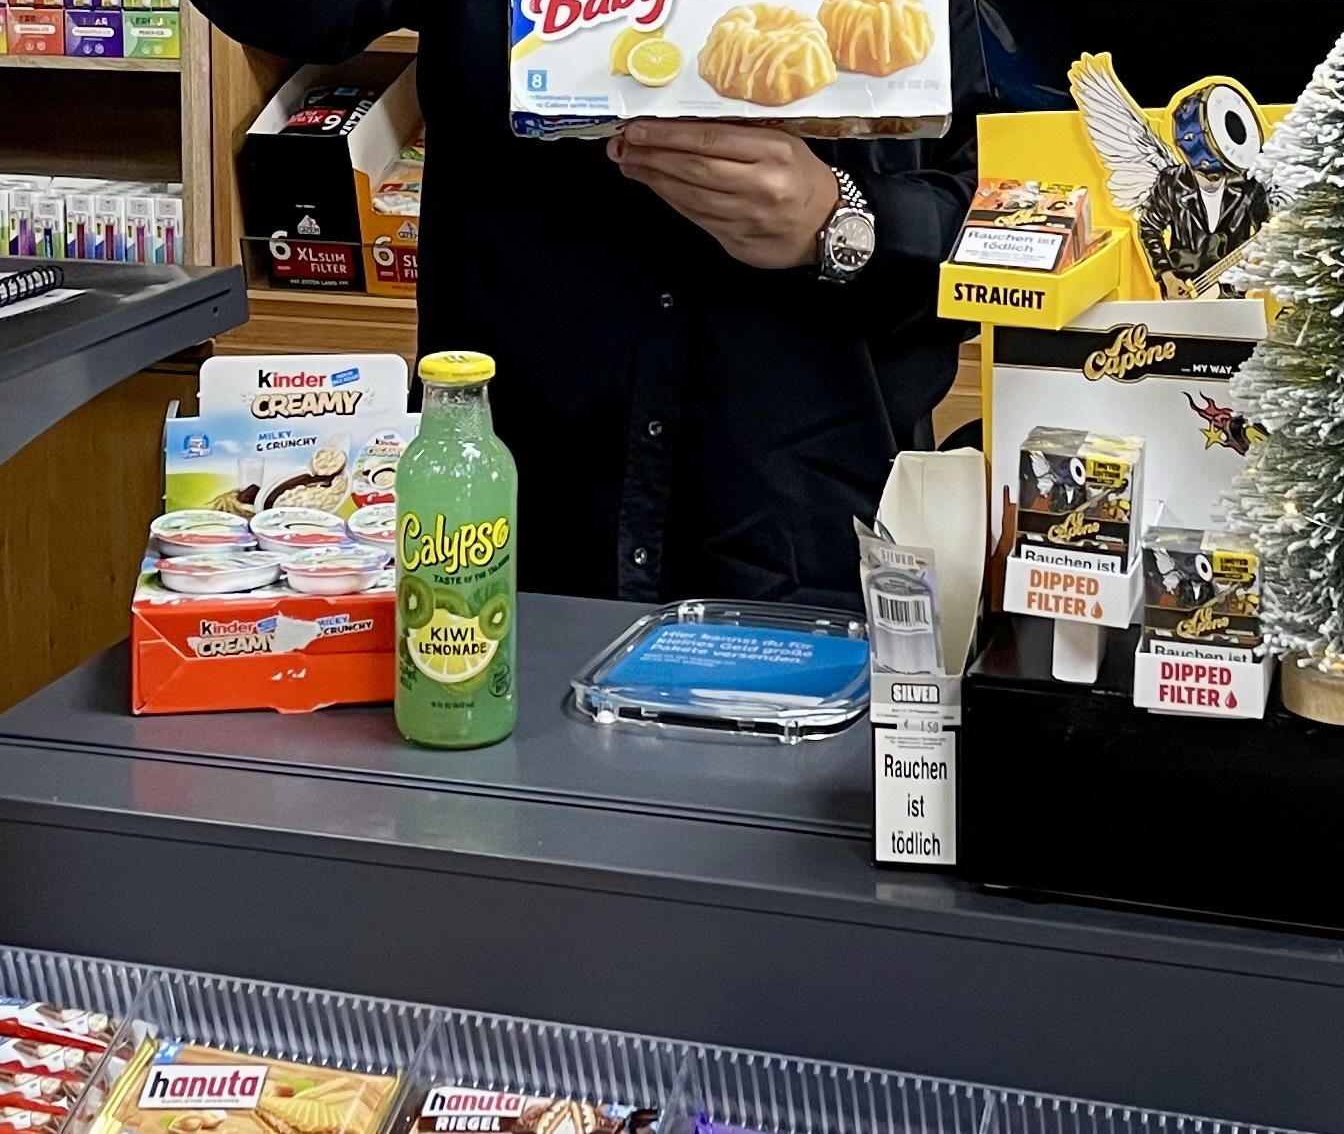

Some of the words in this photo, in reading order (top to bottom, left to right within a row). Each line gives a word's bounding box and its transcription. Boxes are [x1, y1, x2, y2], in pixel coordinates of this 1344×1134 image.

[531, 72, 544, 88] 8
[269, 230, 291, 260] 6
[968, 231, 1033, 242] Rauchen
[1036, 236, 1056, 246] ist
[318, 252, 345, 263] SLIM
[310, 263, 347, 274] FILTER
[954, 283, 1045, 310] STRAIGHT
[1084, 341, 1176, 381] Capone
[251, 390, 363, 419] CREAMY
[259, 430, 292, 442] MILKY
[266, 436, 317, 450] CRUNCHY
[399, 513, 510, 574] Calypso
[1025, 551, 1092, 570] Rauchen
[1030, 569, 1099, 596] DIPPED
[1027, 591, 1087, 617] FILTER
[323, 621, 373, 637] CRUNCHY
[430, 628, 476, 642] KIWI
[663, 631, 694, 639] Hier
[762, 638, 784, 647] du
[418, 642, 488, 656] LEMONADE
[720, 642, 759, 654] Geld
[1161, 661, 1232, 685] DIPPED
[893, 684, 939, 703] SILVER
[1159, 684, 1220, 707] FILTER
[884, 754, 947, 780] Rauchen
[907, 794, 925, 818] ist
[892, 831, 941, 856] tödlich
[146, 1070, 263, 1102] hanuta
[428, 1089, 523, 1115] hanuta
[434, 1116, 502, 1132] RIEGEL
